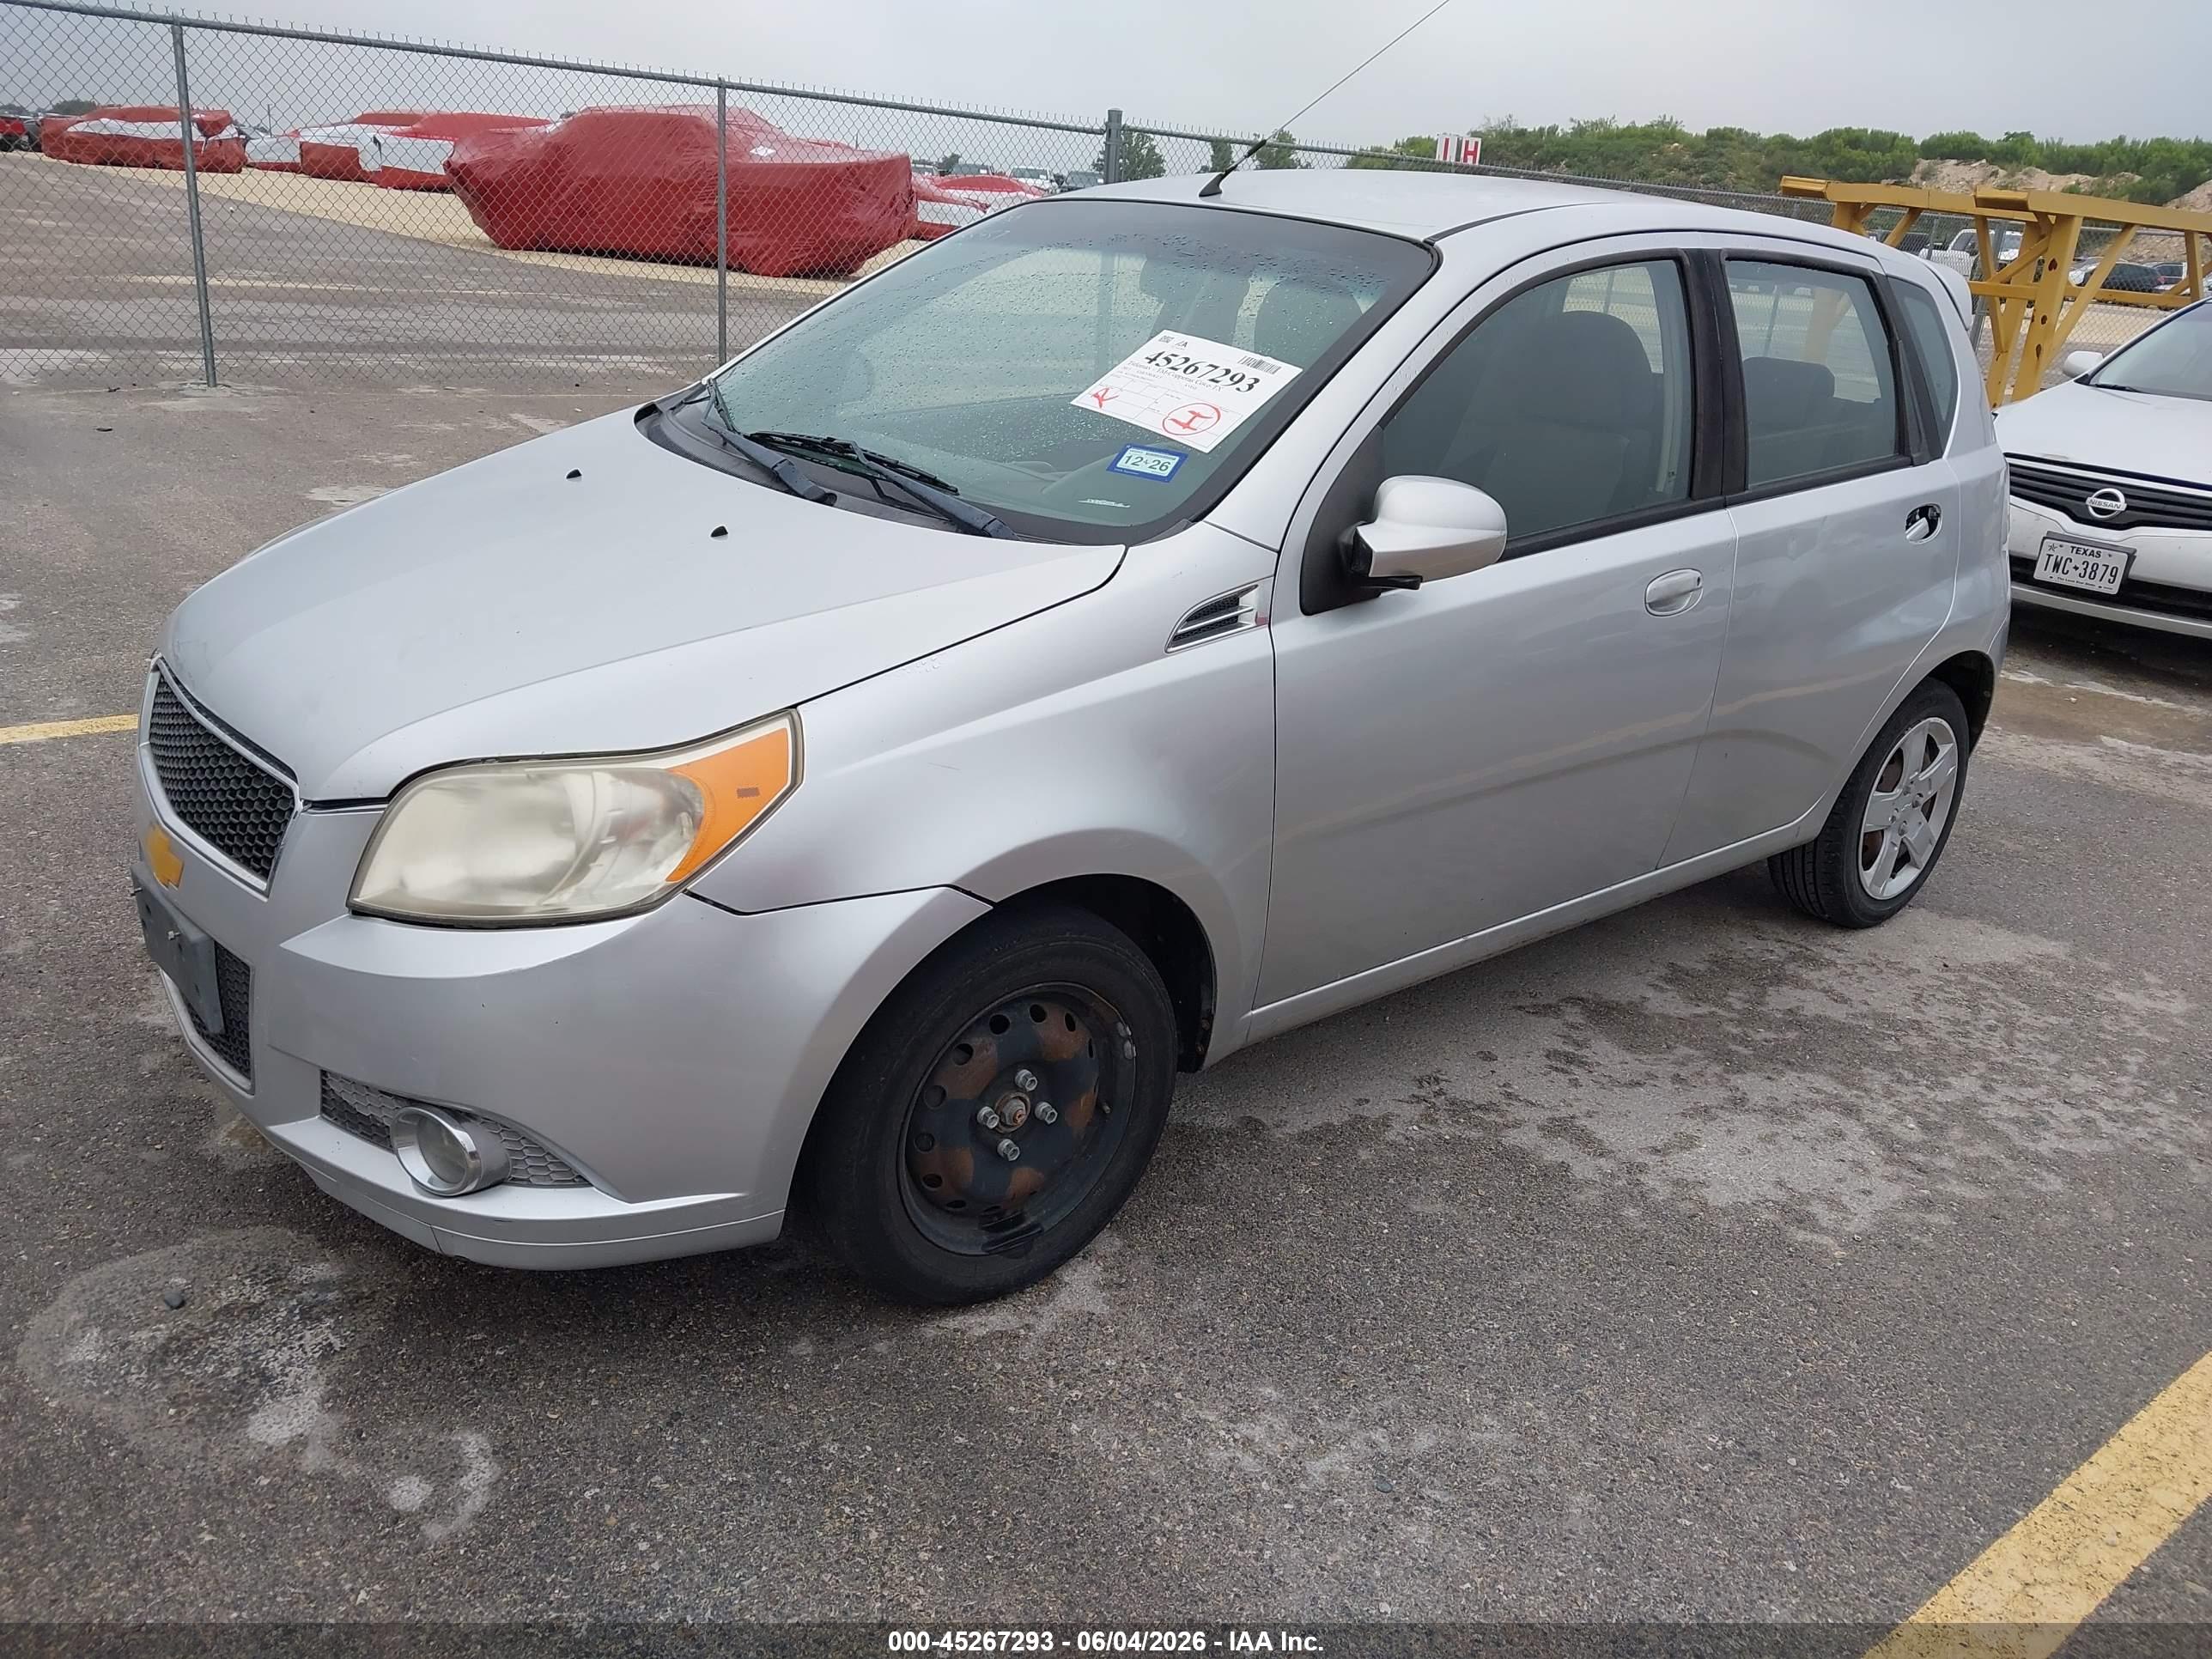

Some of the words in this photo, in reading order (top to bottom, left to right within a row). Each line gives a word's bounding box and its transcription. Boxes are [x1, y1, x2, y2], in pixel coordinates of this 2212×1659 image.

[1462, 139, 1479, 164] H
[1145, 350, 1261, 392] 45267293
[1124, 454, 1144, 467] 12
[1148, 459, 1171, 471] 26
[2088, 498, 2122, 509] NISSAN
[2069, 545, 2102, 558] TEXAS
